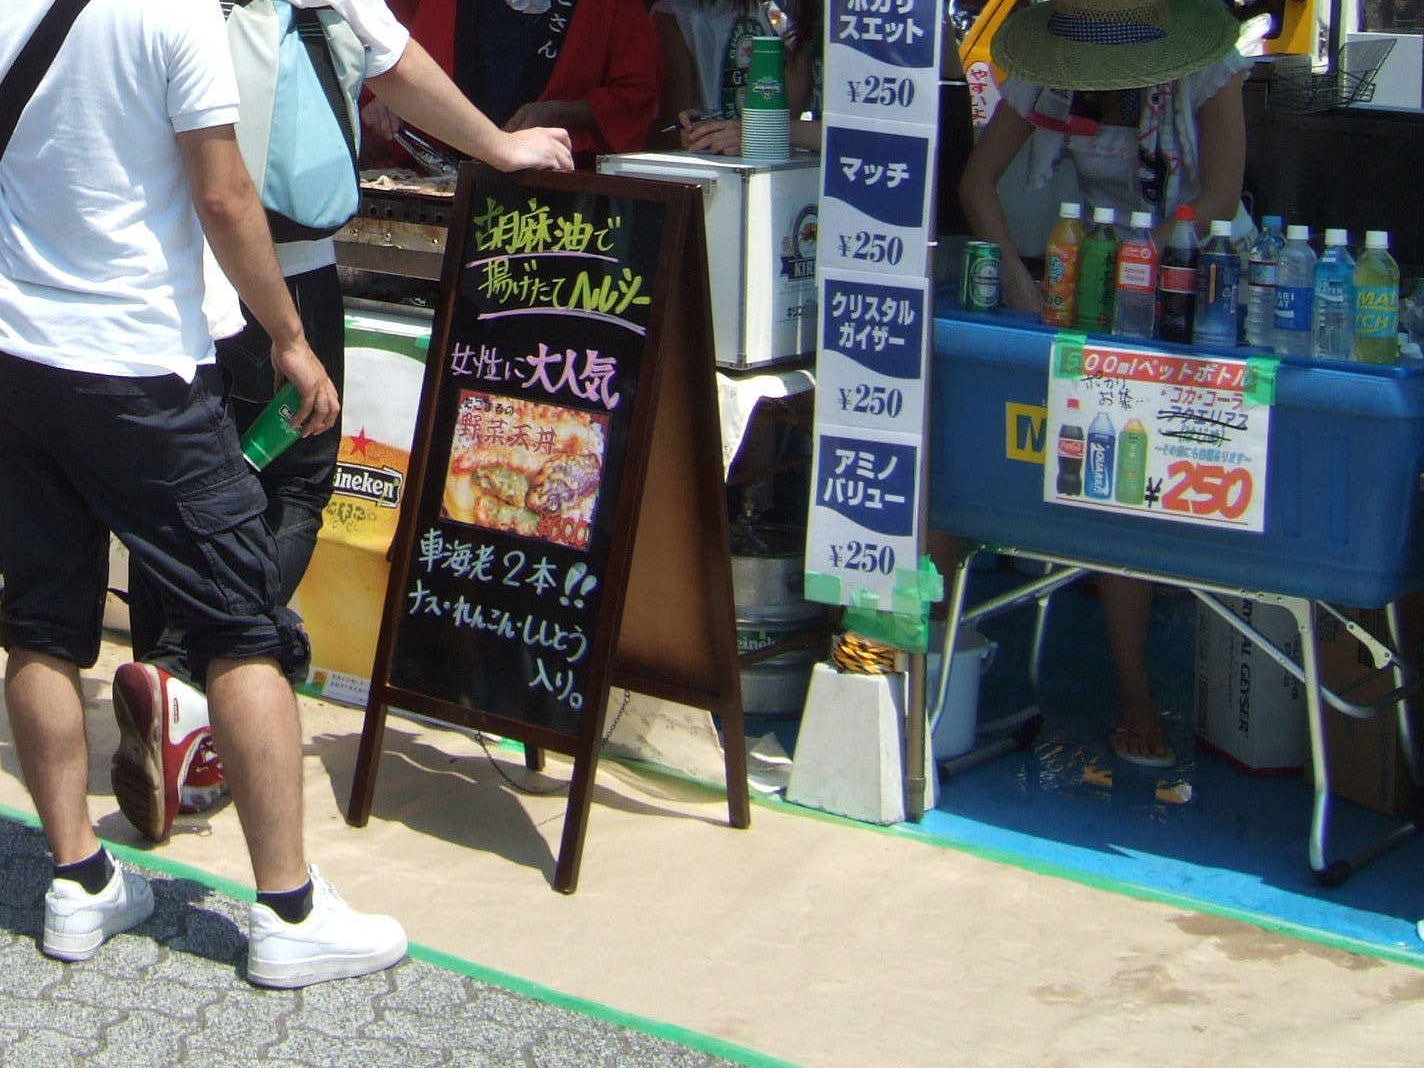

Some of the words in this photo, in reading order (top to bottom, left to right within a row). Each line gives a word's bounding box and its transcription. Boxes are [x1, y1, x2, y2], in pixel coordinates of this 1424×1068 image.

[839, 16, 923, 45] スエット
[847, 75, 915, 108] ¥250
[839, 155, 910, 190] マッチ
[473, 196, 622, 254] 胡麻油で
[837, 230, 904, 266] ¥250
[794, 260, 816, 277] KIR
[831, 290, 915, 326] クリスタル
[838, 324, 906, 353] ガイザー
[450, 341, 620, 411] 女性に大人気
[837, 383, 903, 419] ¥250
[834, 448, 898, 482] アミノ
[334, 470, 396, 500] ineken
[823, 477, 906, 510] バリュー
[828, 540, 896, 576] ¥250
